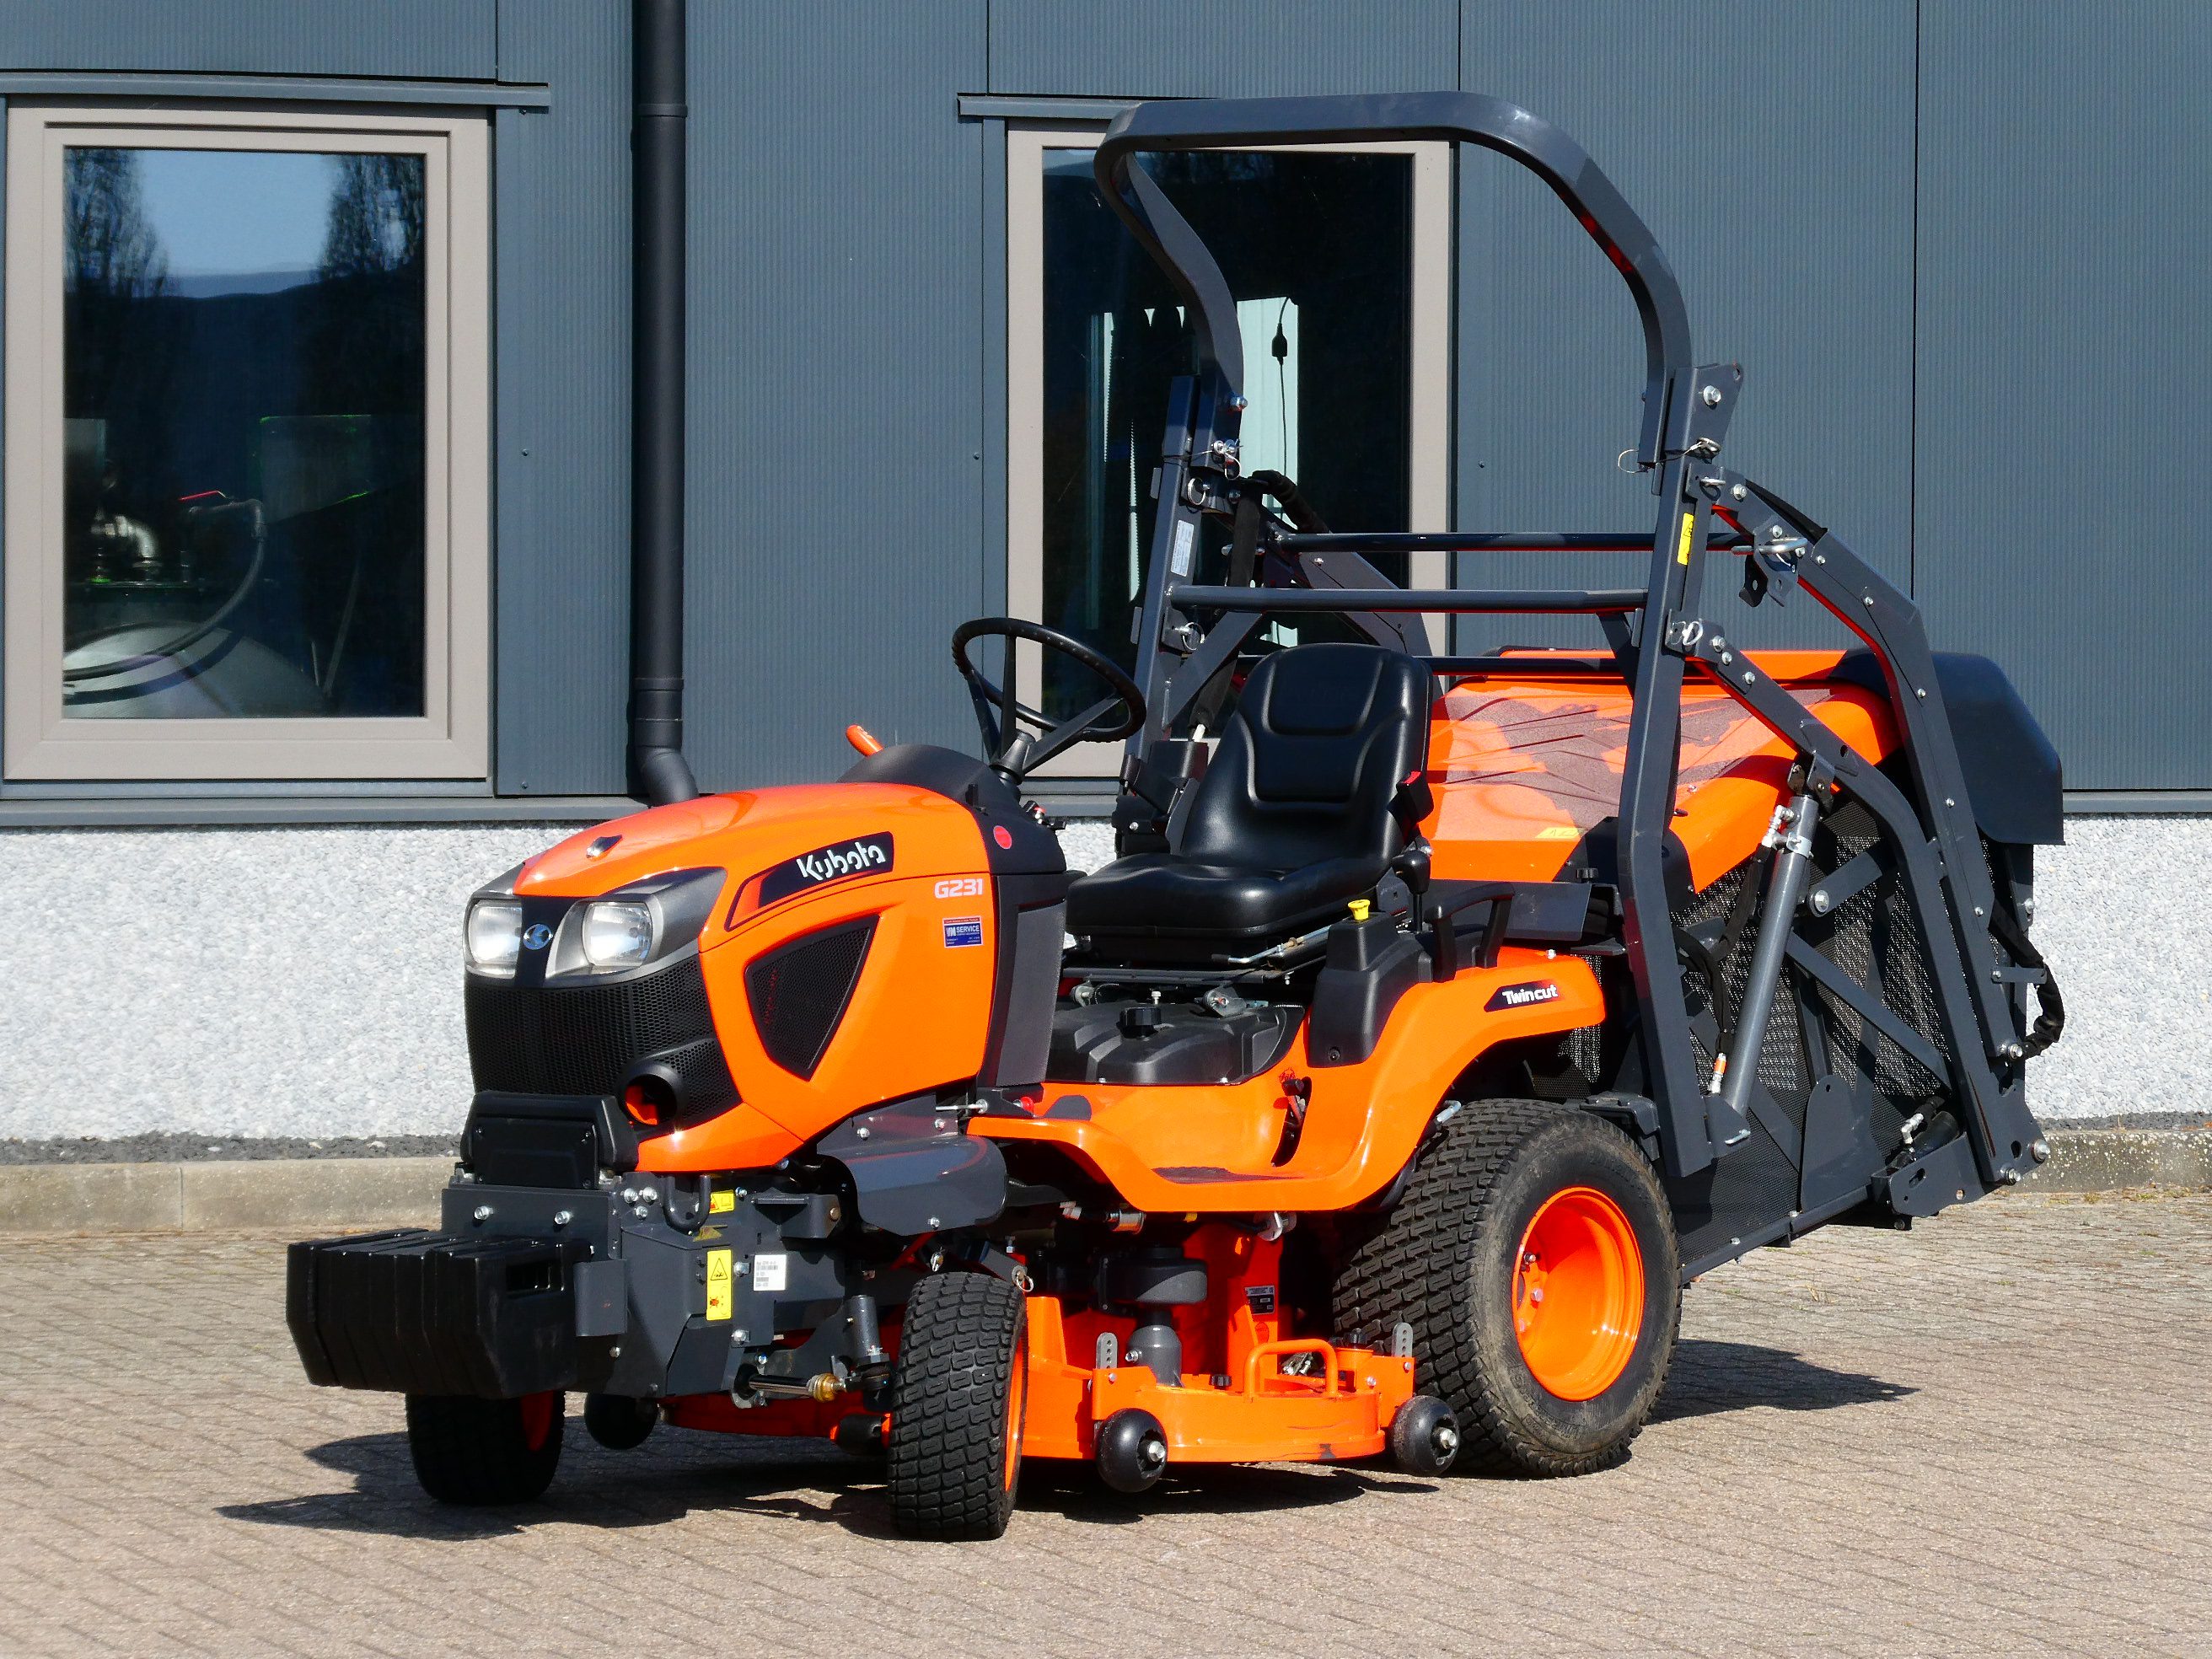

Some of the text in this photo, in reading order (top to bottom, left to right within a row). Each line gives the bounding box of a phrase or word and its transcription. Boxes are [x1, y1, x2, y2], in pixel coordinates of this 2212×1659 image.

[797, 841, 886, 881] Kubota
[934, 878, 984, 899] G231
[956, 925, 980, 933] SERVICE
